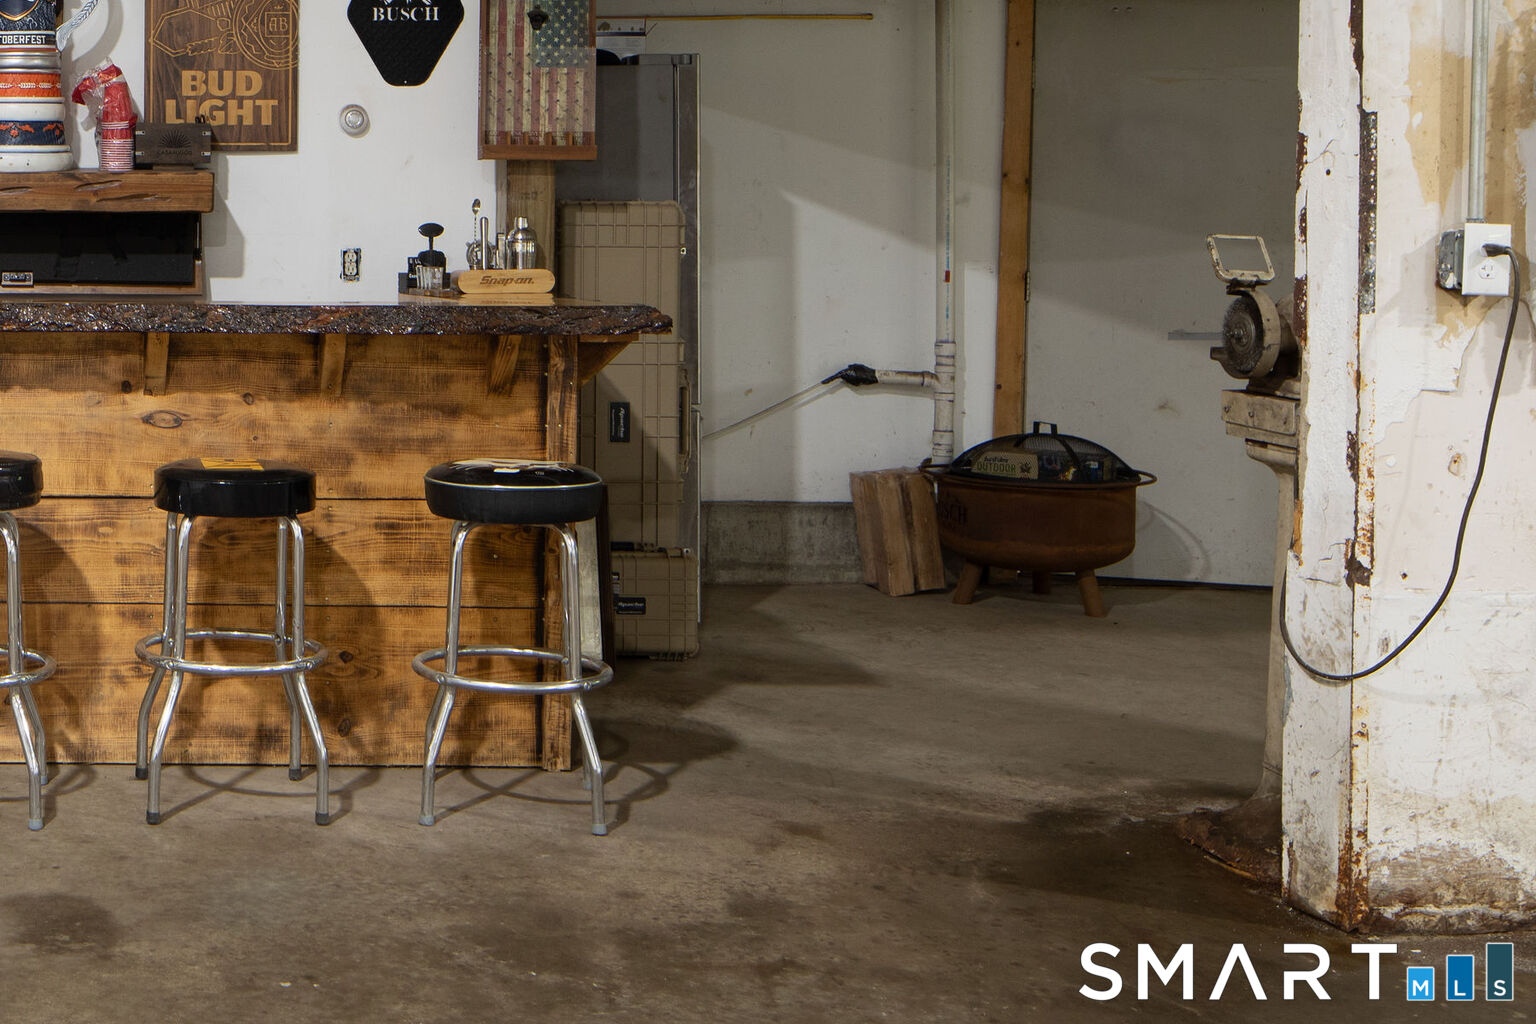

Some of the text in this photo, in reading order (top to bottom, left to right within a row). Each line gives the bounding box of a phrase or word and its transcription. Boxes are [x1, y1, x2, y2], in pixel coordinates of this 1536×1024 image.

[371, 7, 440, 22] BUSCH
[180, 69, 263, 97] BUD
[165, 98, 279, 126] LIGHT
[976, 461, 1017, 473] OUTDOOR
